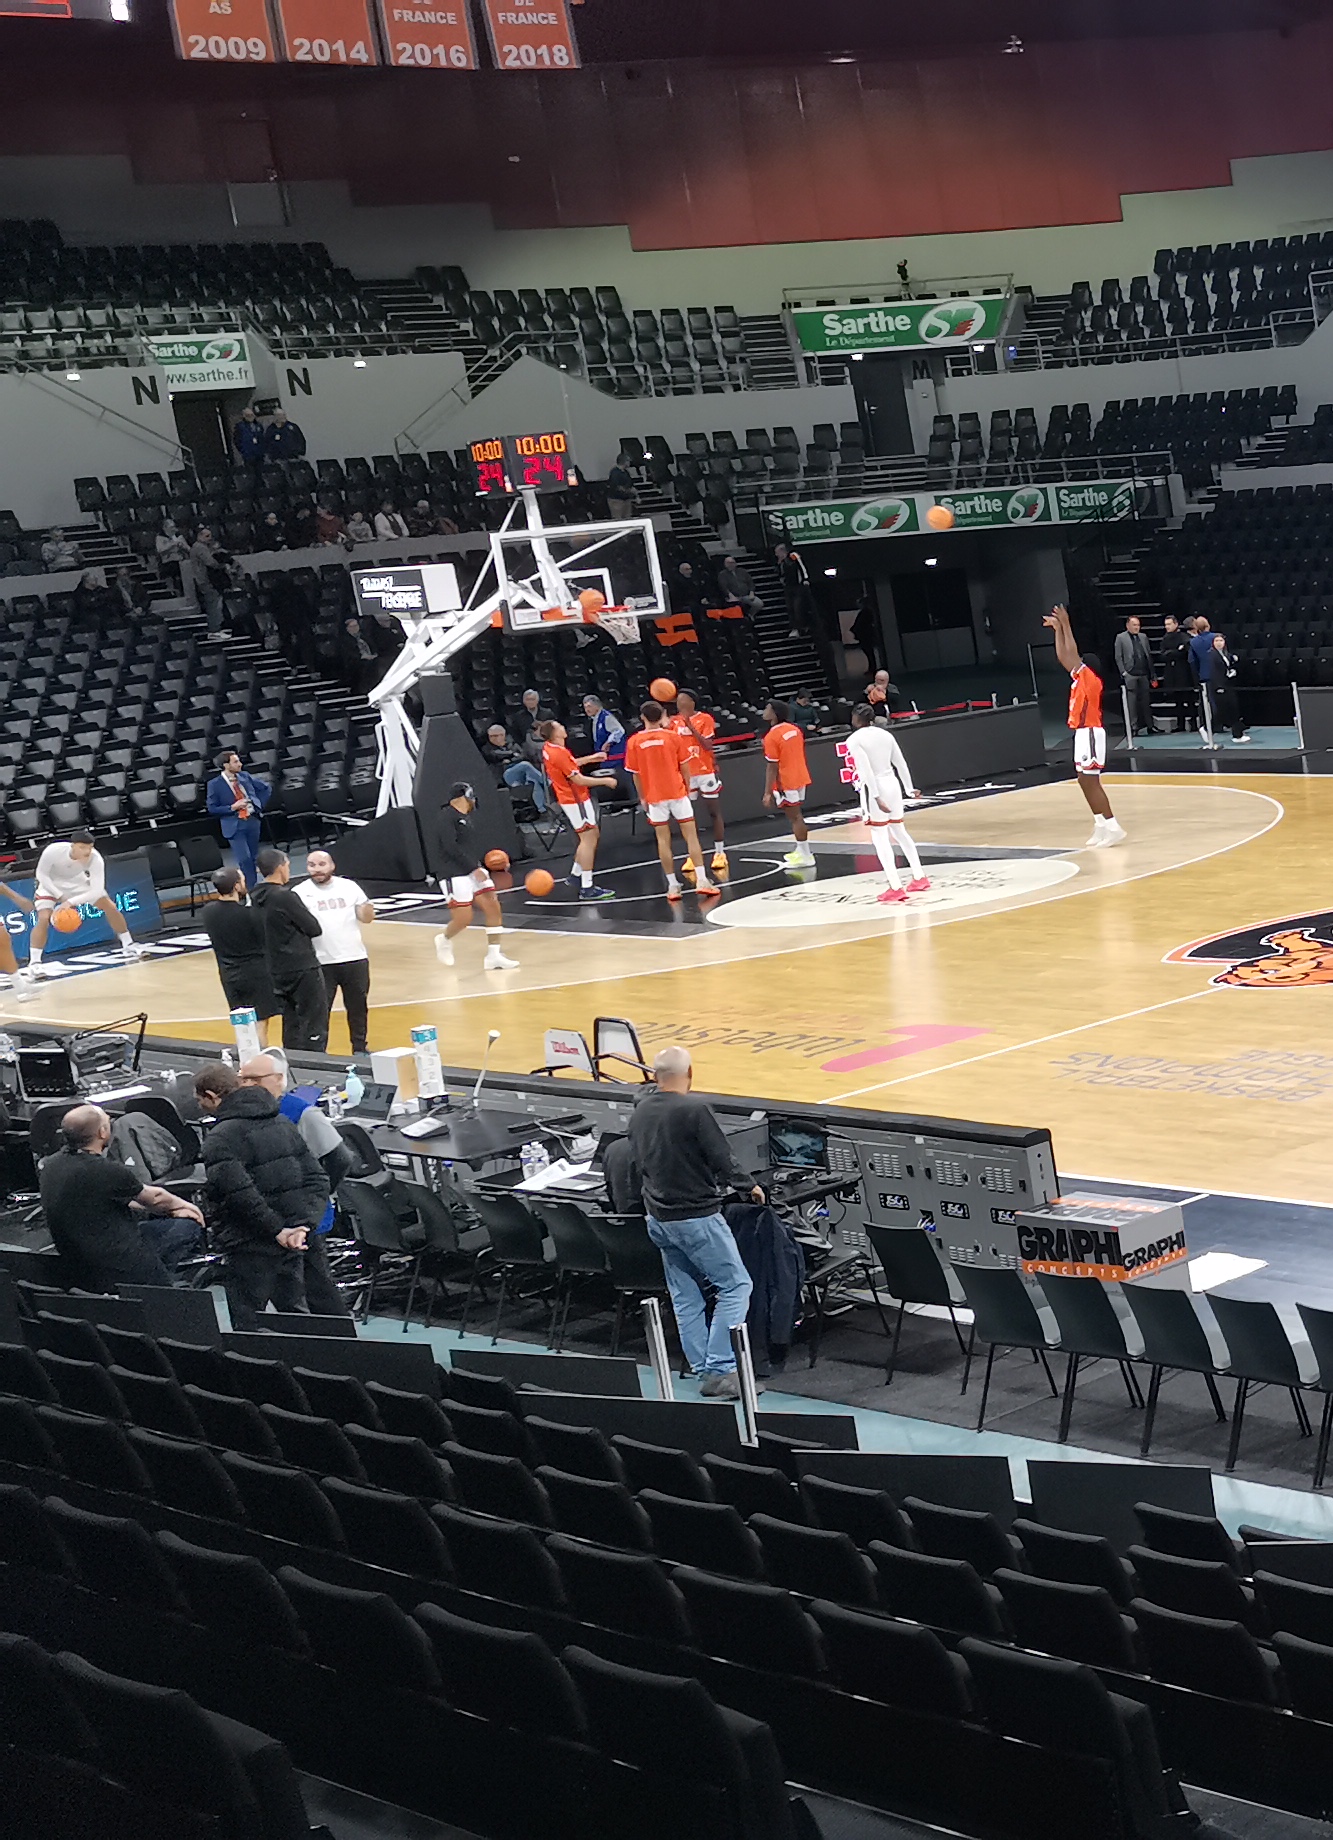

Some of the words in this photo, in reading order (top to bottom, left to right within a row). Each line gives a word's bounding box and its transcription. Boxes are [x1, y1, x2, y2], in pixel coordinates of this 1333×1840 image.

[209, 2, 232, 14] AS
[393, 9, 458, 25] FRANCE
[497, 12, 558, 25] FRANCE
[187, 35, 267, 62] 2009
[293, 37, 369, 65] 2014
[396, 42, 467, 67] 2016
[502, 44, 569, 67] 2018
[823, 310, 911, 335] Sarthe
[149, 344, 199, 358] Sarthe
[132, 375, 161, 406] N
[286, 367, 313, 396] N
[471, 440, 503, 462] 10:00
[515, 433, 566, 456] 10:00
[477, 463, 504, 492] 24
[523, 456, 565, 485] 24
[940, 494, 1003, 515] Sarthe
[1059, 488, 1109, 508] Sarthe
[769, 508, 845, 531] Sarthe
[761, 890, 954, 907] PUNIER
[1050, 1068, 1324, 1102] BASKETBALL
[1017, 1225, 1124, 1267] GRAPHI
[1122, 1230, 1186, 1272] GRAPHI
[1026, 1263, 1118, 1278] CONCEPTS
